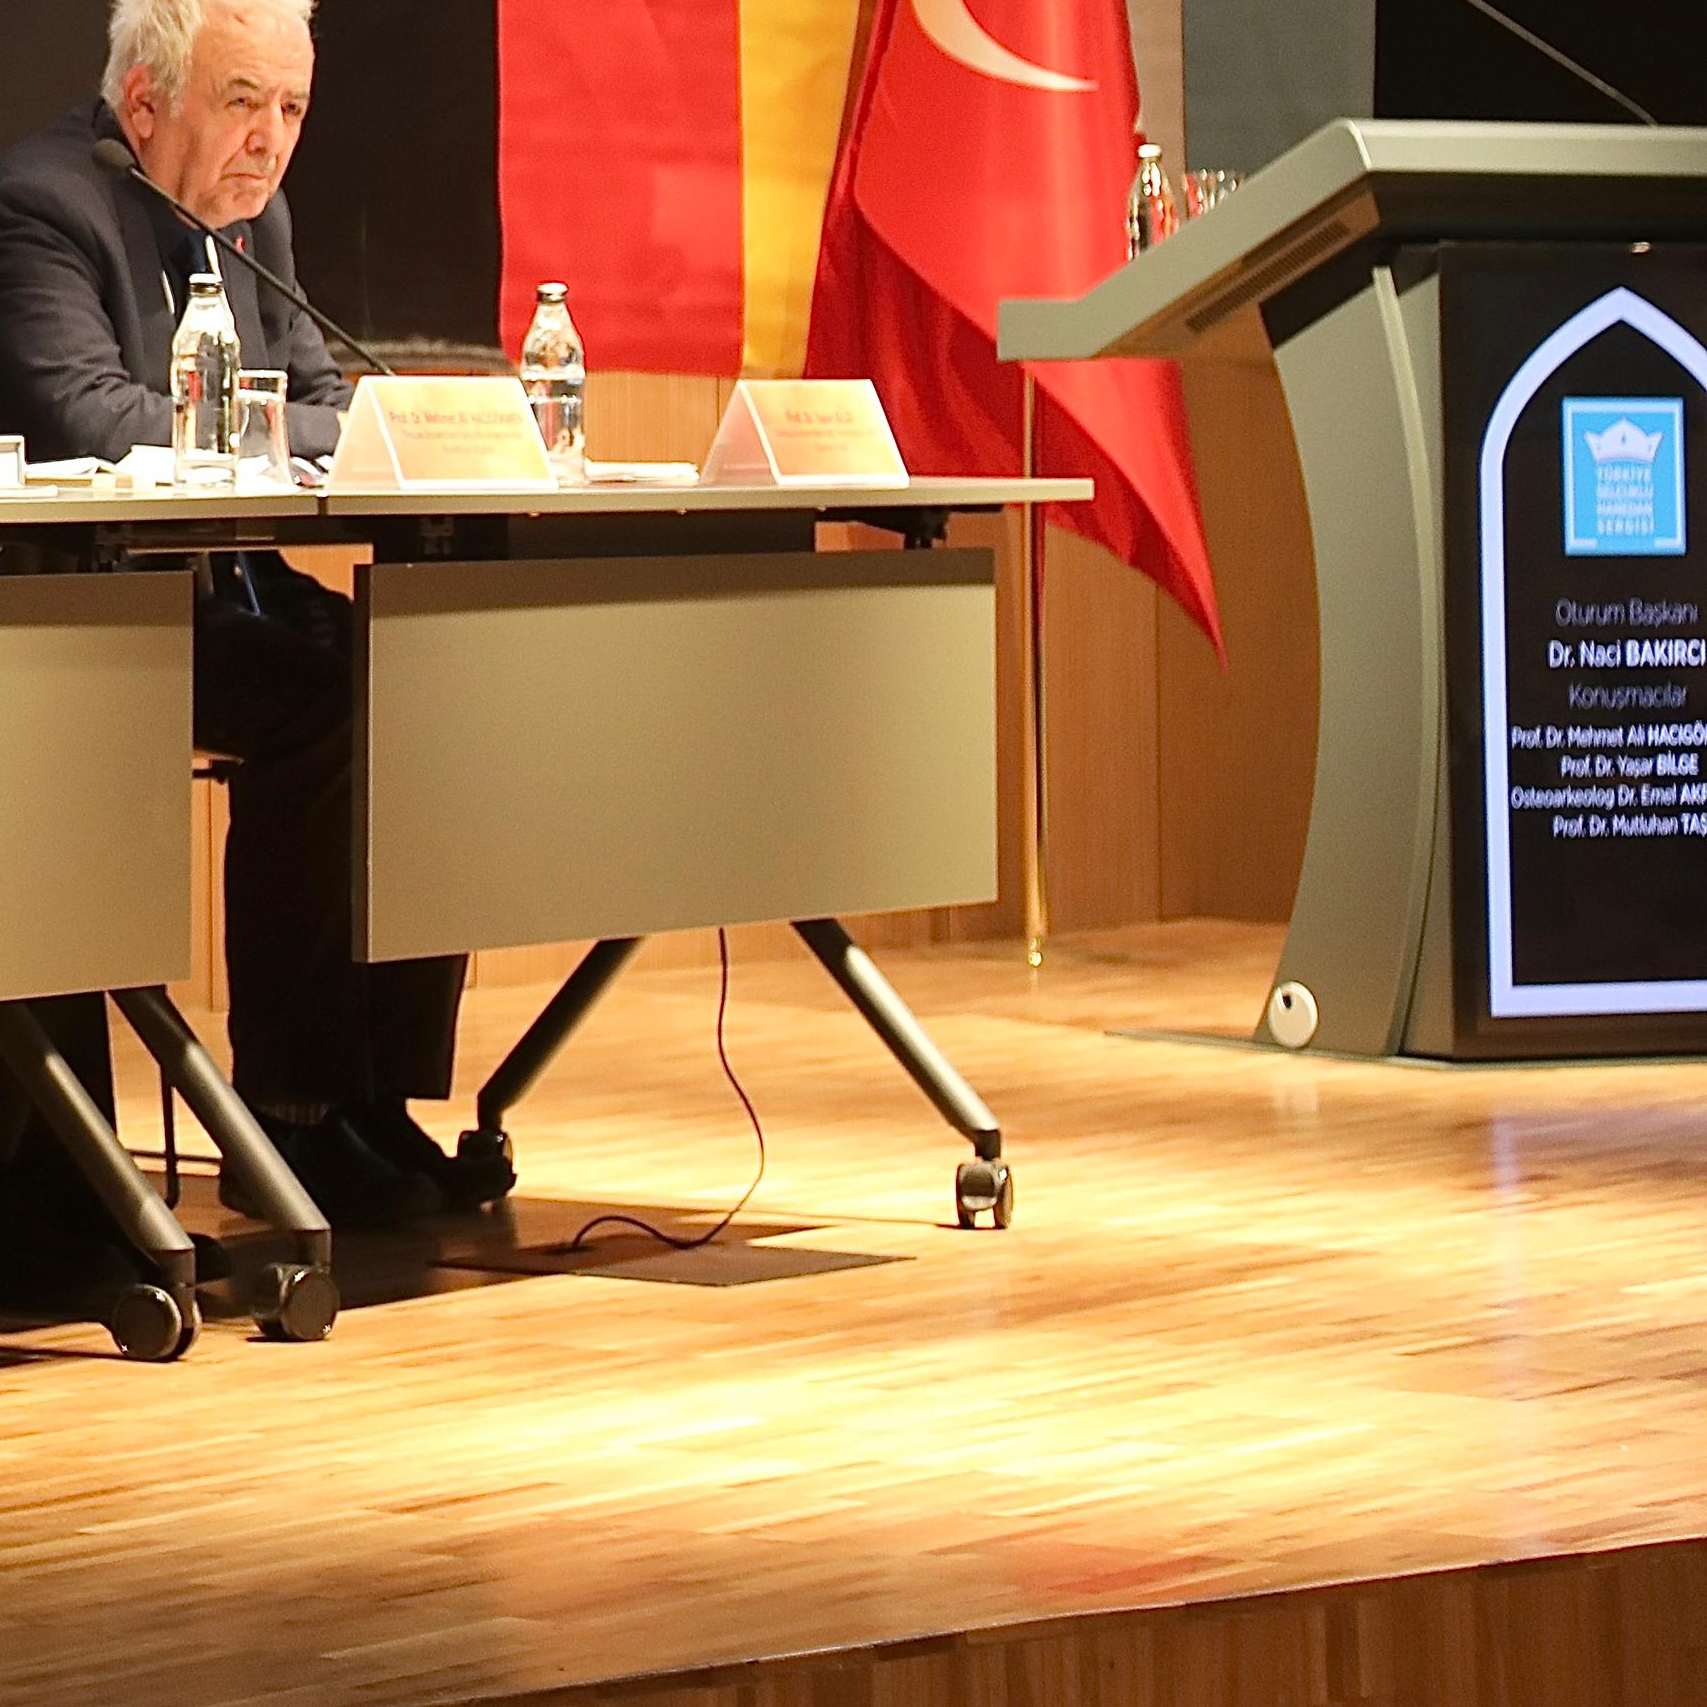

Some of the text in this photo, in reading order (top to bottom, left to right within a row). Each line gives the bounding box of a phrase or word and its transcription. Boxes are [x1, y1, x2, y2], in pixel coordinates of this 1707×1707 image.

[1555, 598, 1698, 628] Oturum Başkanı
[1549, 639, 1706, 668] Dr. Naci BAKIRCI
[1568, 681, 1687, 710] Konuşmacılar
[1512, 720, 1707, 748] Prof. Dr. Mehmet Ali HACIGÖ
[1561, 754, 1592, 778] Prof.
[1595, 754, 1615, 778] Dr.
[1656, 750, 1699, 777] BİLGE
[1618, 784, 1637, 808] Dr.
[1641, 783, 1677, 807] Emel
[1553, 814, 1587, 837] Prof.
[1589, 814, 1610, 837] Dr.
[1613, 813, 1678, 837] Mutluhan
